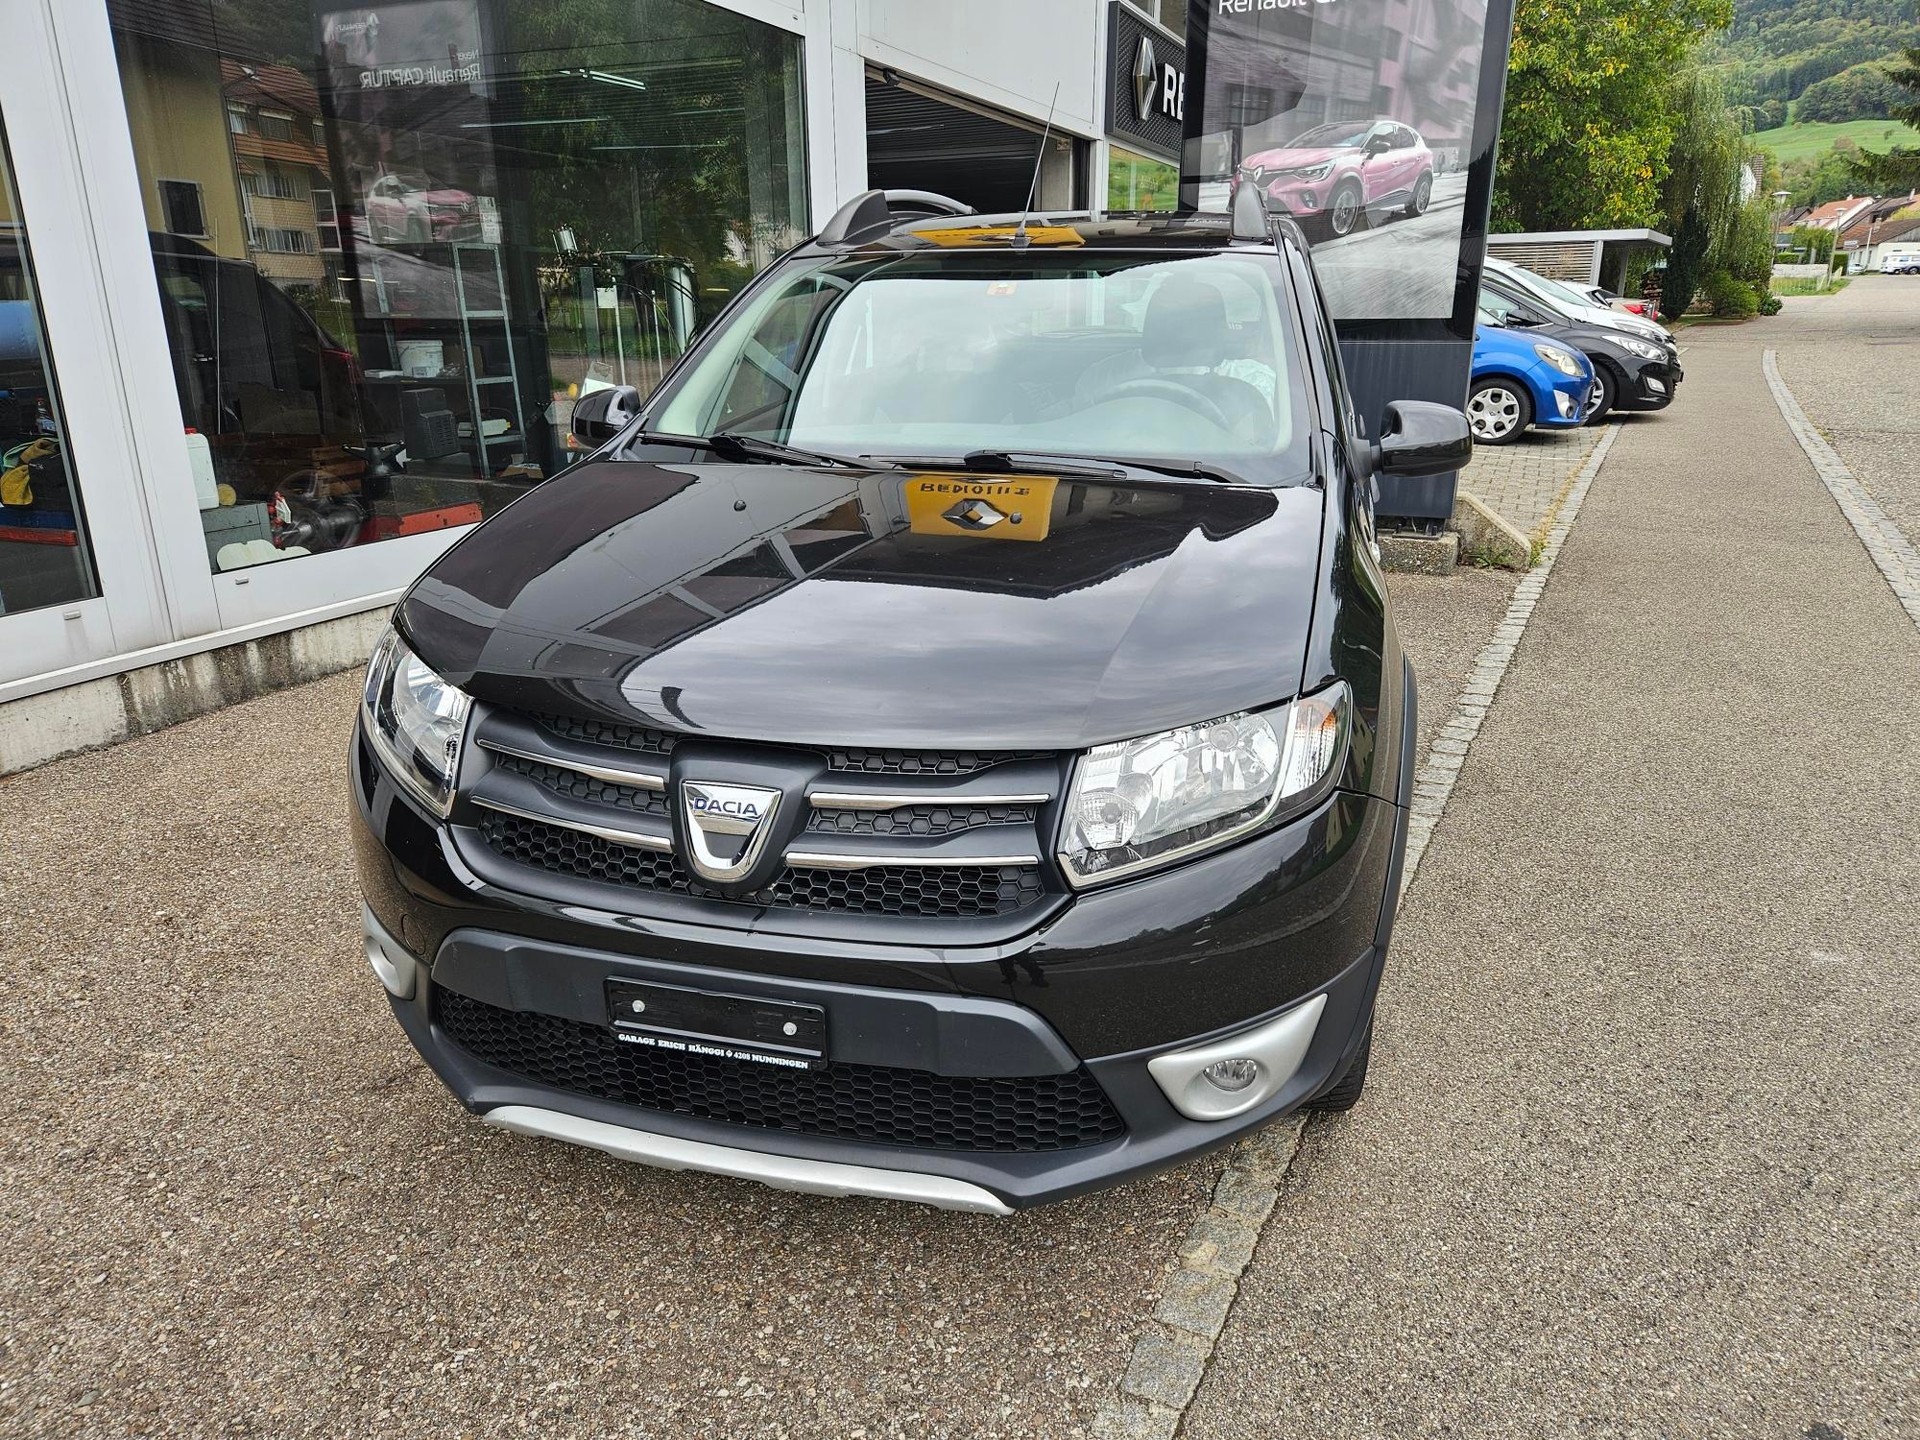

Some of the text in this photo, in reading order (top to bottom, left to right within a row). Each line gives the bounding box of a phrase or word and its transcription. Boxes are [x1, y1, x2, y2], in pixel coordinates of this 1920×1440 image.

[694, 798, 758, 815] DACIA
[618, 1033, 655, 1046] GARAGE
[658, 1039, 686, 1051] ERICH
[688, 1044, 724, 1057] HÄNGGI
[751, 1054, 809, 1069] NUNNINGEN
